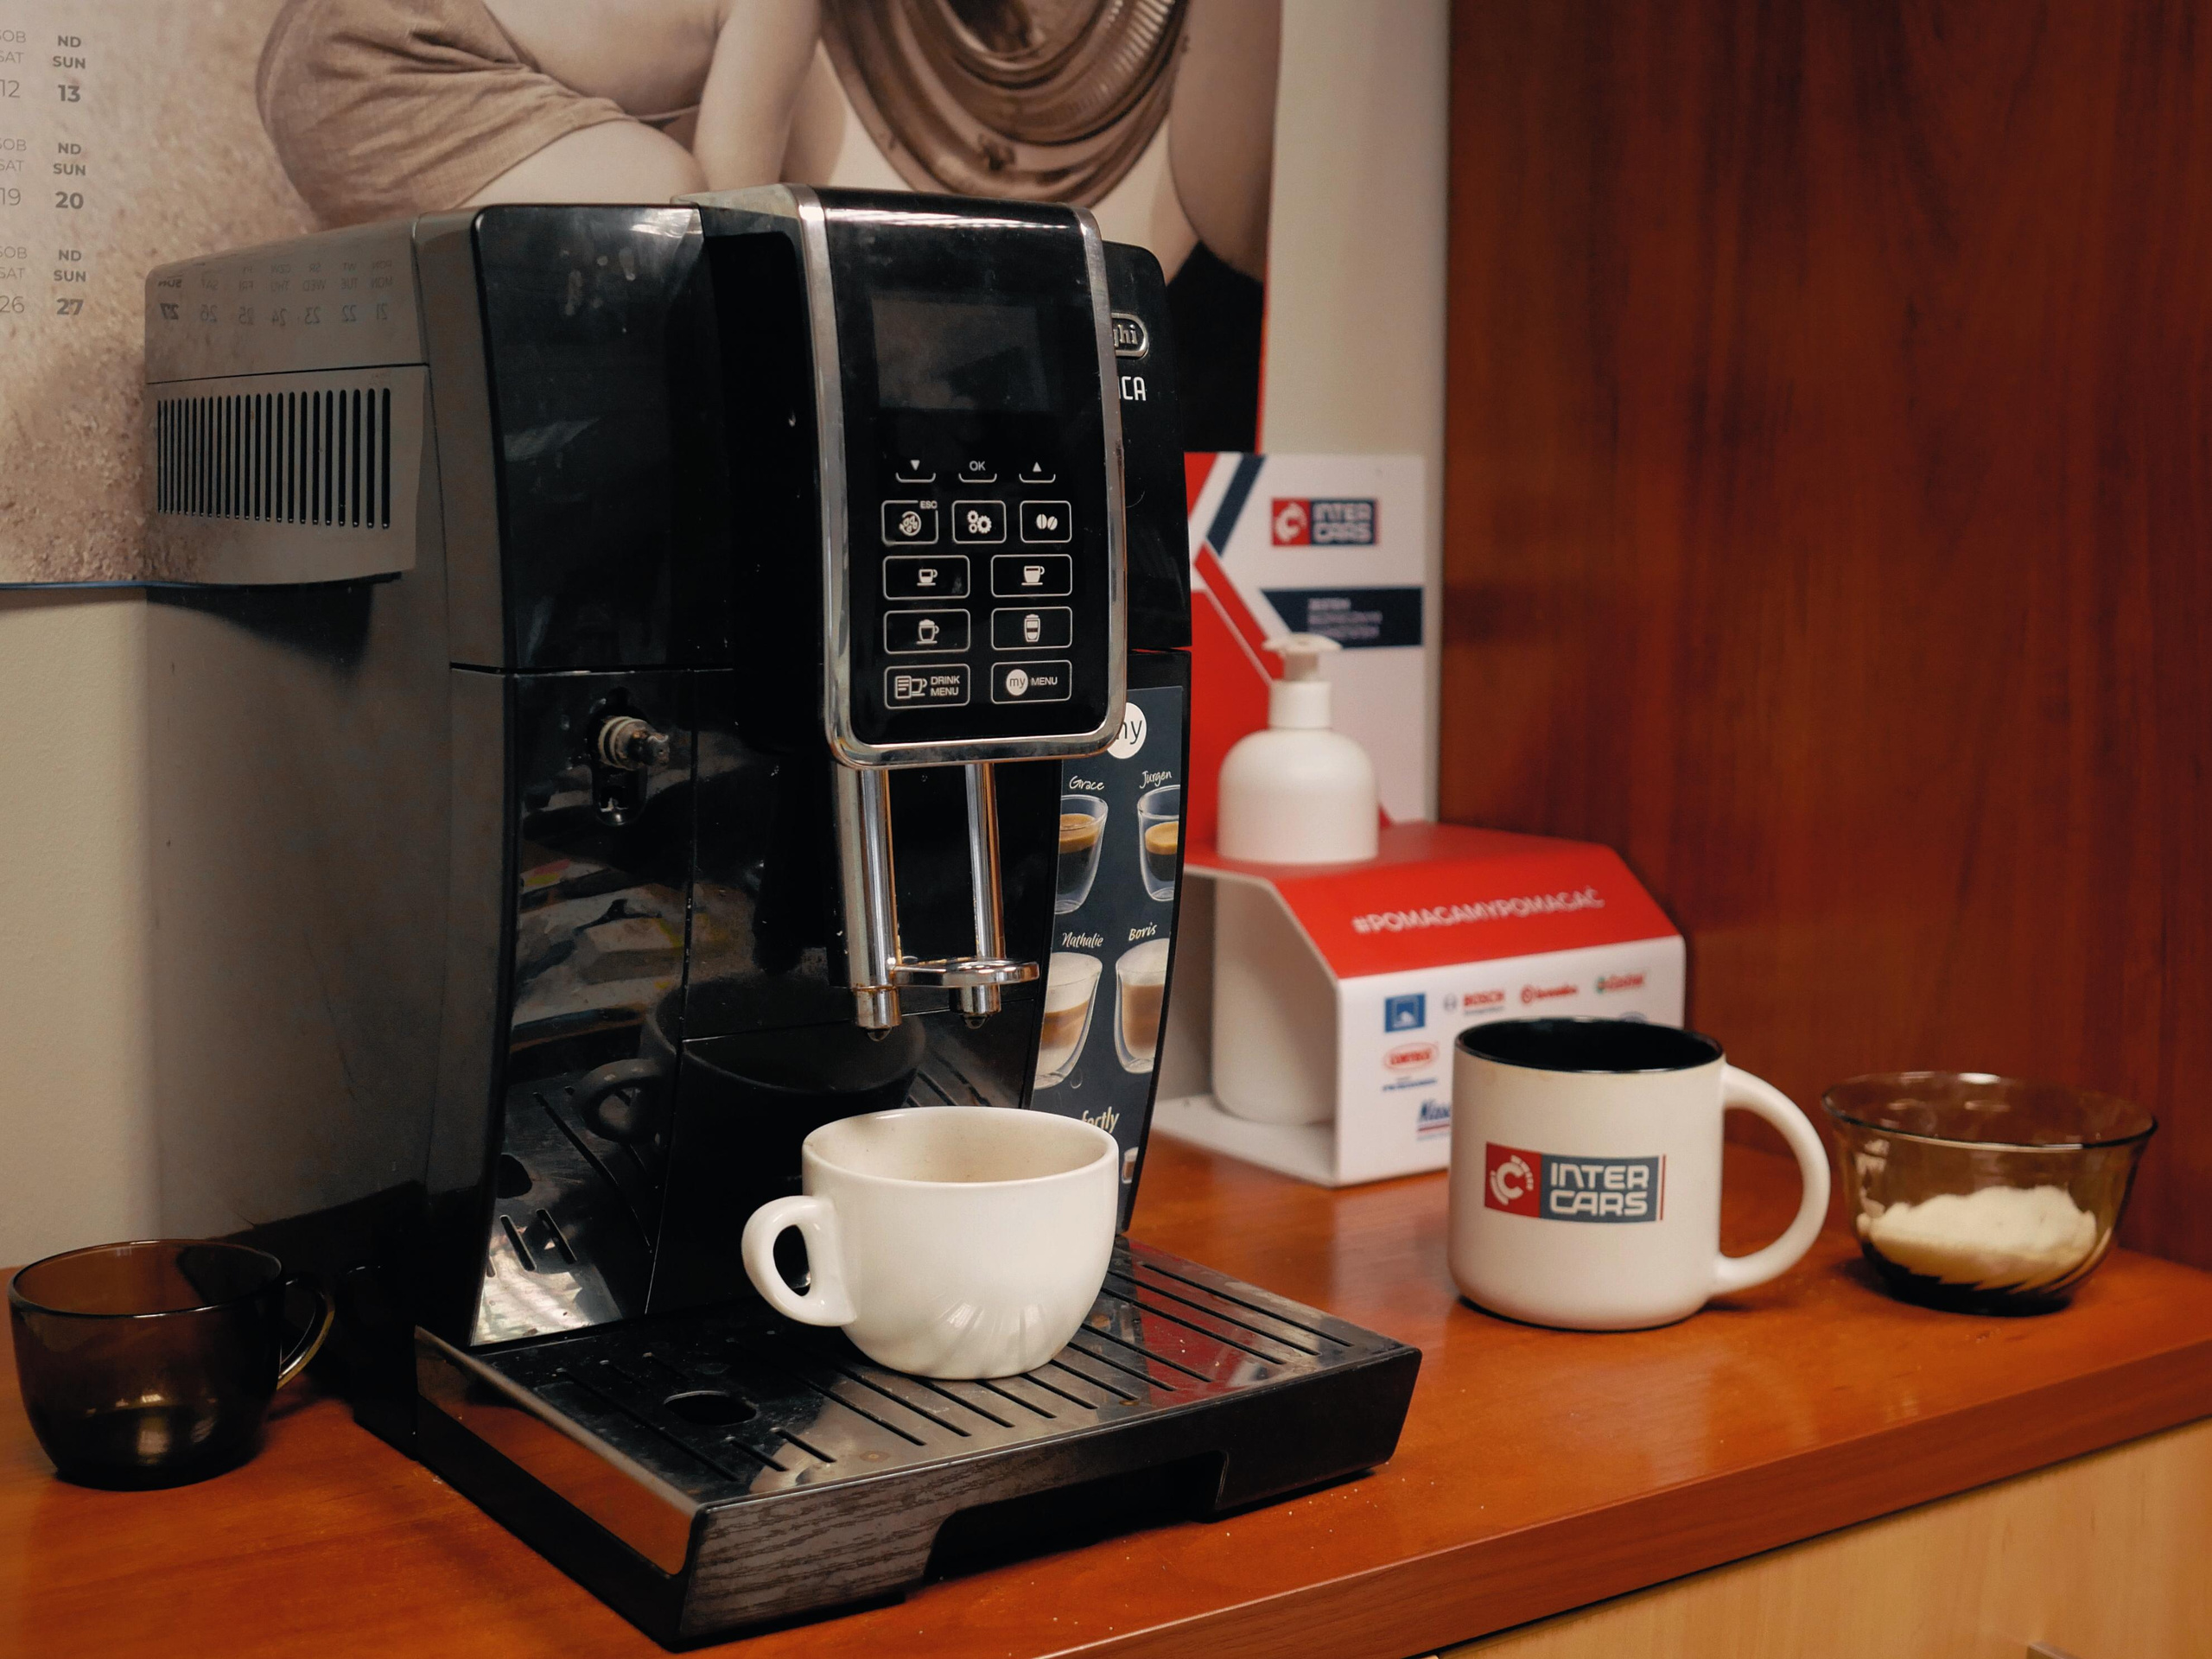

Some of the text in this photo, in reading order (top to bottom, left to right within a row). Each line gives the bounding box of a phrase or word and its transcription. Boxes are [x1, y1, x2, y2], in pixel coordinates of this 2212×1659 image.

[0, 29, 81, 48] OB ND
[53, 56, 86, 69] SUN
[0, 79, 81, 103] 12 13
[0, 138, 81, 155] OB ND
[53, 162, 86, 175] SUN
[0, 188, 84, 209] 19 20
[0, 246, 81, 262] OB ND
[54, 270, 86, 283] SUN
[0, 296, 84, 315] 26 27
[969, 461, 986, 471] OK
[920, 500, 938, 509] ESC
[931, 676, 960, 685] DRINK
[1009, 677, 1058, 689] my MENU
[931, 687, 959, 696] MENU
[1069, 776, 1104, 791] Grace
[1128, 922, 1157, 941] Boris
[1061, 931, 1103, 949] Nathalie
[1550, 1162, 1649, 1190] INTER
[1549, 1189, 1649, 1217] CARS
